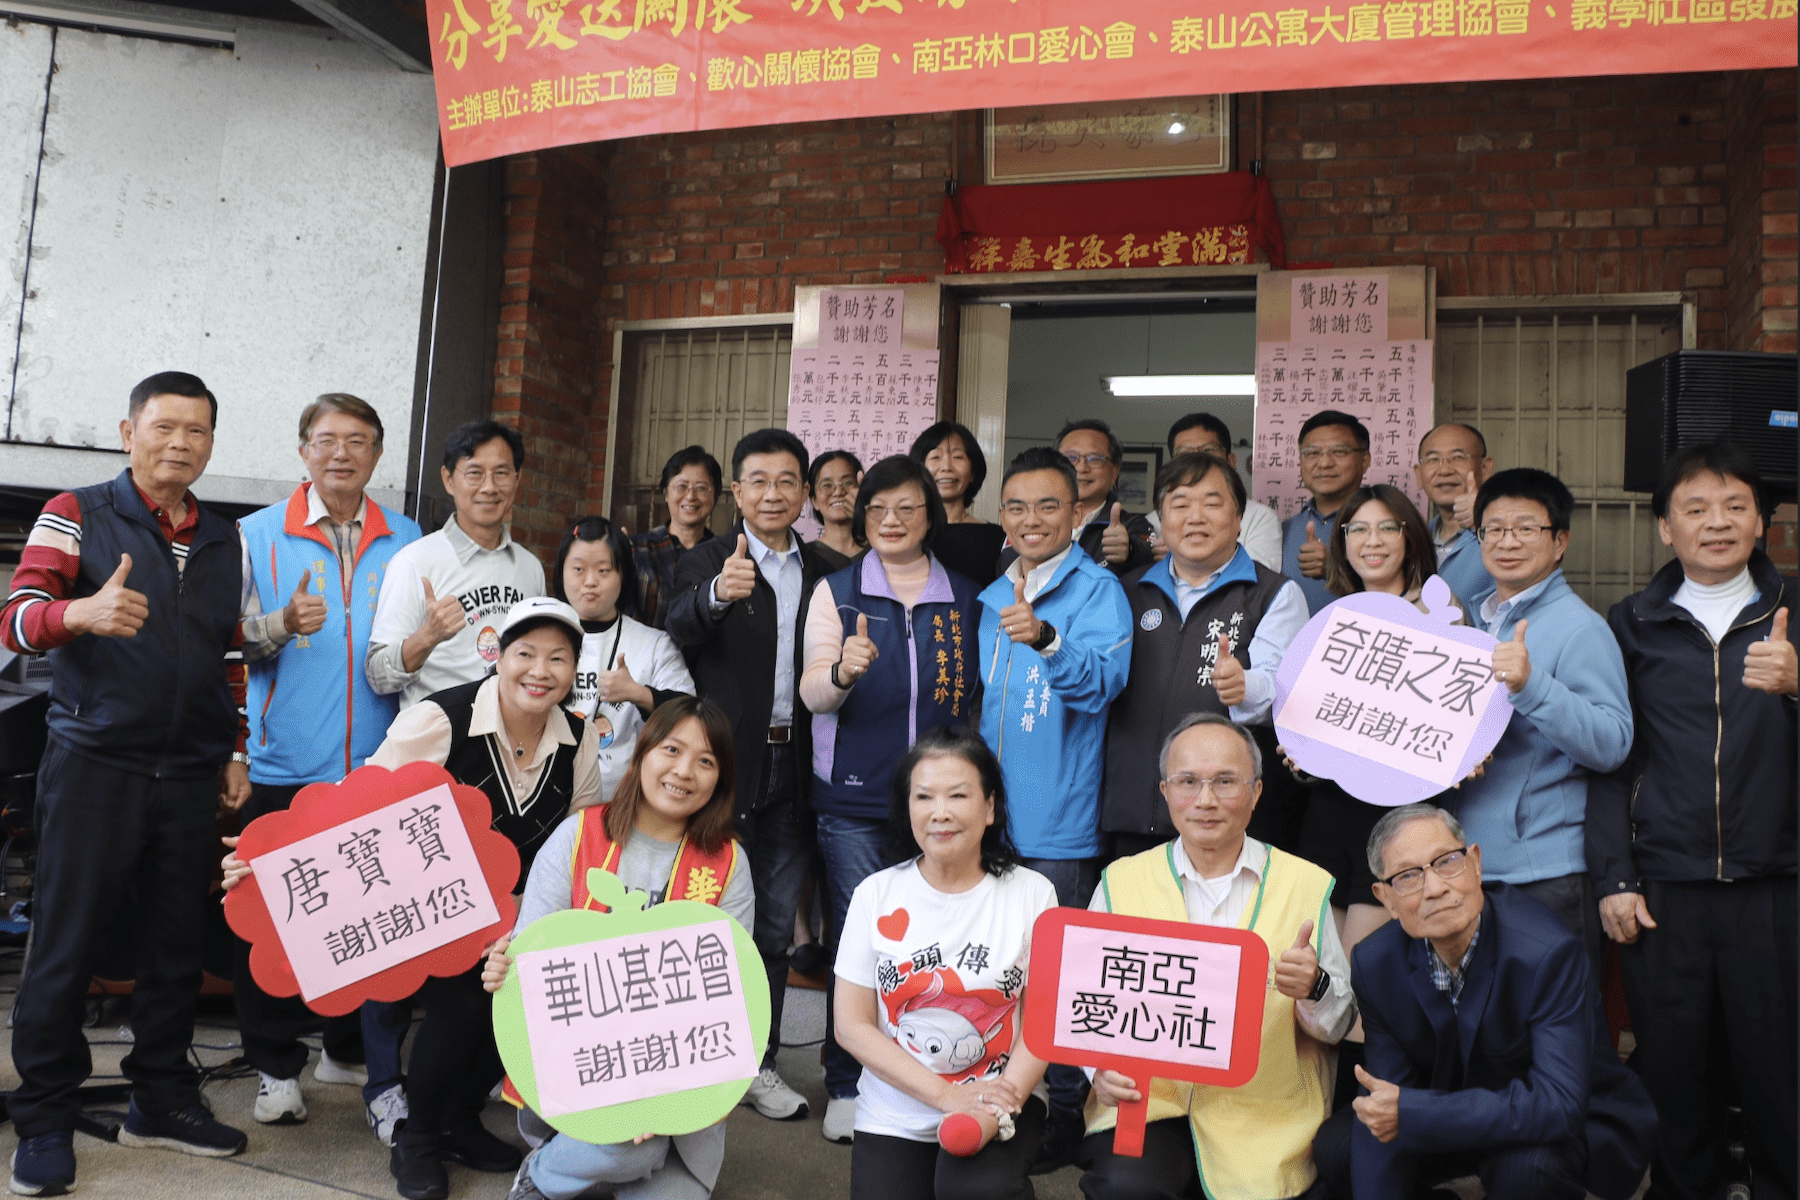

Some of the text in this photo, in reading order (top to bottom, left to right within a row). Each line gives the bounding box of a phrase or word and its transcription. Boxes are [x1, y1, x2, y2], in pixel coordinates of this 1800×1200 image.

[833, 325, 888, 343] 謝謝您
[1308, 313, 1373, 334] 謝謝您
[874, 354, 888, 405] 五百元
[1272, 347, 1287, 402] 三萬元
[1301, 347, 1316, 402] 三千元
[1330, 349, 1346, 402] 二萬元
[1359, 348, 1374, 402] 二千元
[1387, 347, 1402, 403] 五千元
[1269, 413, 1284, 467] 二千元
[1385, 408, 1401, 466] 五千元
[1321, 620, 1495, 717] 奇蹟之家
[1038, 679, 1051, 717] 委員
[1315, 692, 1453, 763] 謝謝您
[280, 804, 451, 924] 唐寶寶
[323, 878, 475, 966] 謝謝您
[541, 933, 733, 1026] 華山基金會
[1100, 946, 1199, 999] 南亞
[1070, 992, 1217, 1051] 愛心社
[573, 1021, 736, 1086] 謝謝您
